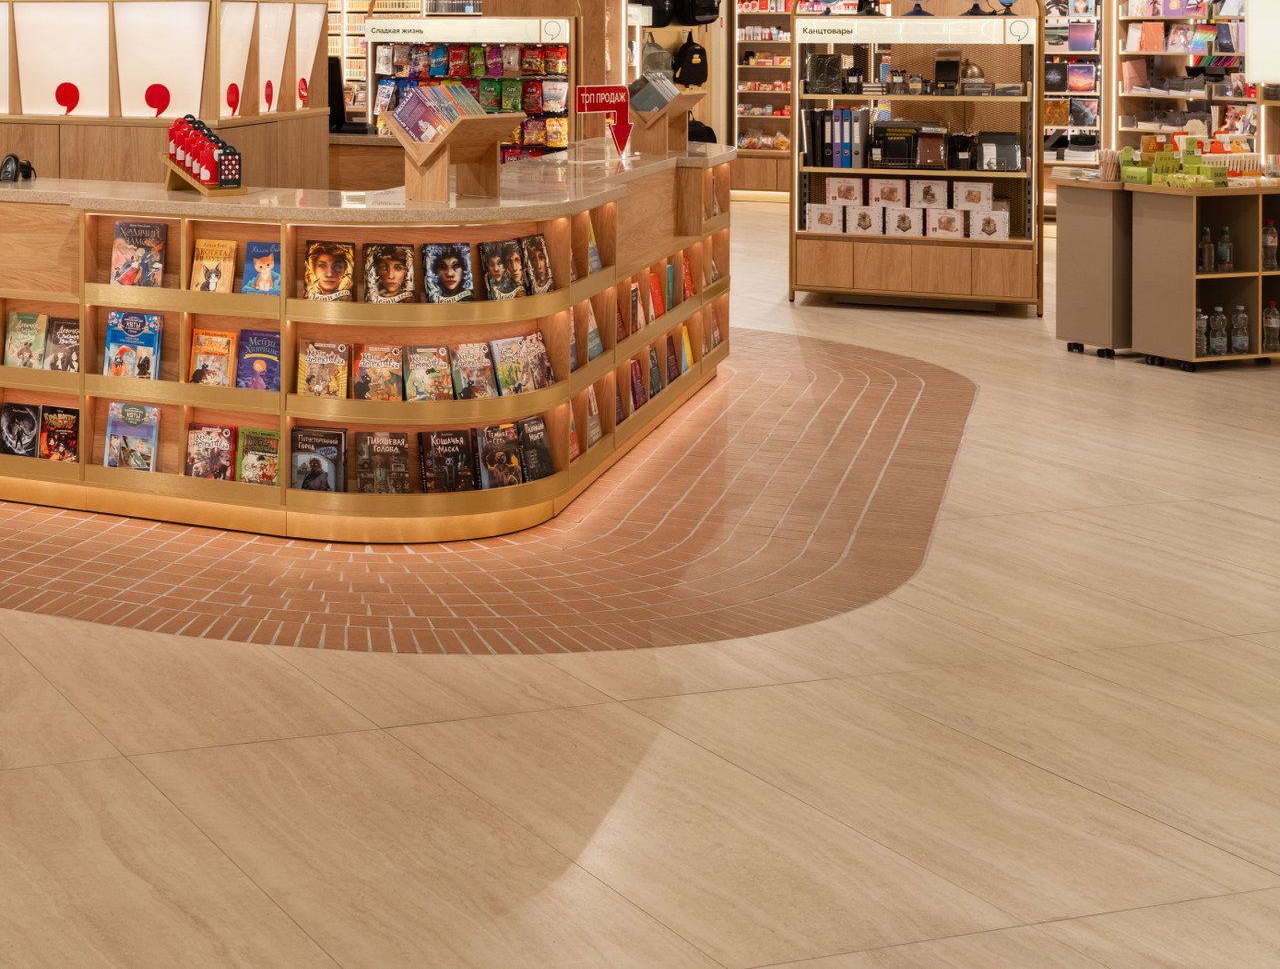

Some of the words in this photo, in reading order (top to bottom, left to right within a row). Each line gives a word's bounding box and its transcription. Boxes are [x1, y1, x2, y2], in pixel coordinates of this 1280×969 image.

[370, 27, 401, 35] Сладкая
[802, 27, 854, 37] Канцтовары
[580, 93, 595, 104] ТОП
[596, 92, 627, 105] ПРОДАЖ
[120, 226, 160, 239] ХОДЯЧИЙ
[248, 336, 276, 348] Мейзи
[245, 345, 278, 356] Хитчинс
[367, 436, 405, 447] ПЛЮШЕВАЯ
[430, 433, 464, 445] КОШАЧЬЯ
[297, 443, 315, 451] ГОРОД
[372, 445, 399, 454] ГОЛОВА
[437, 445, 460, 454] МАСКА
